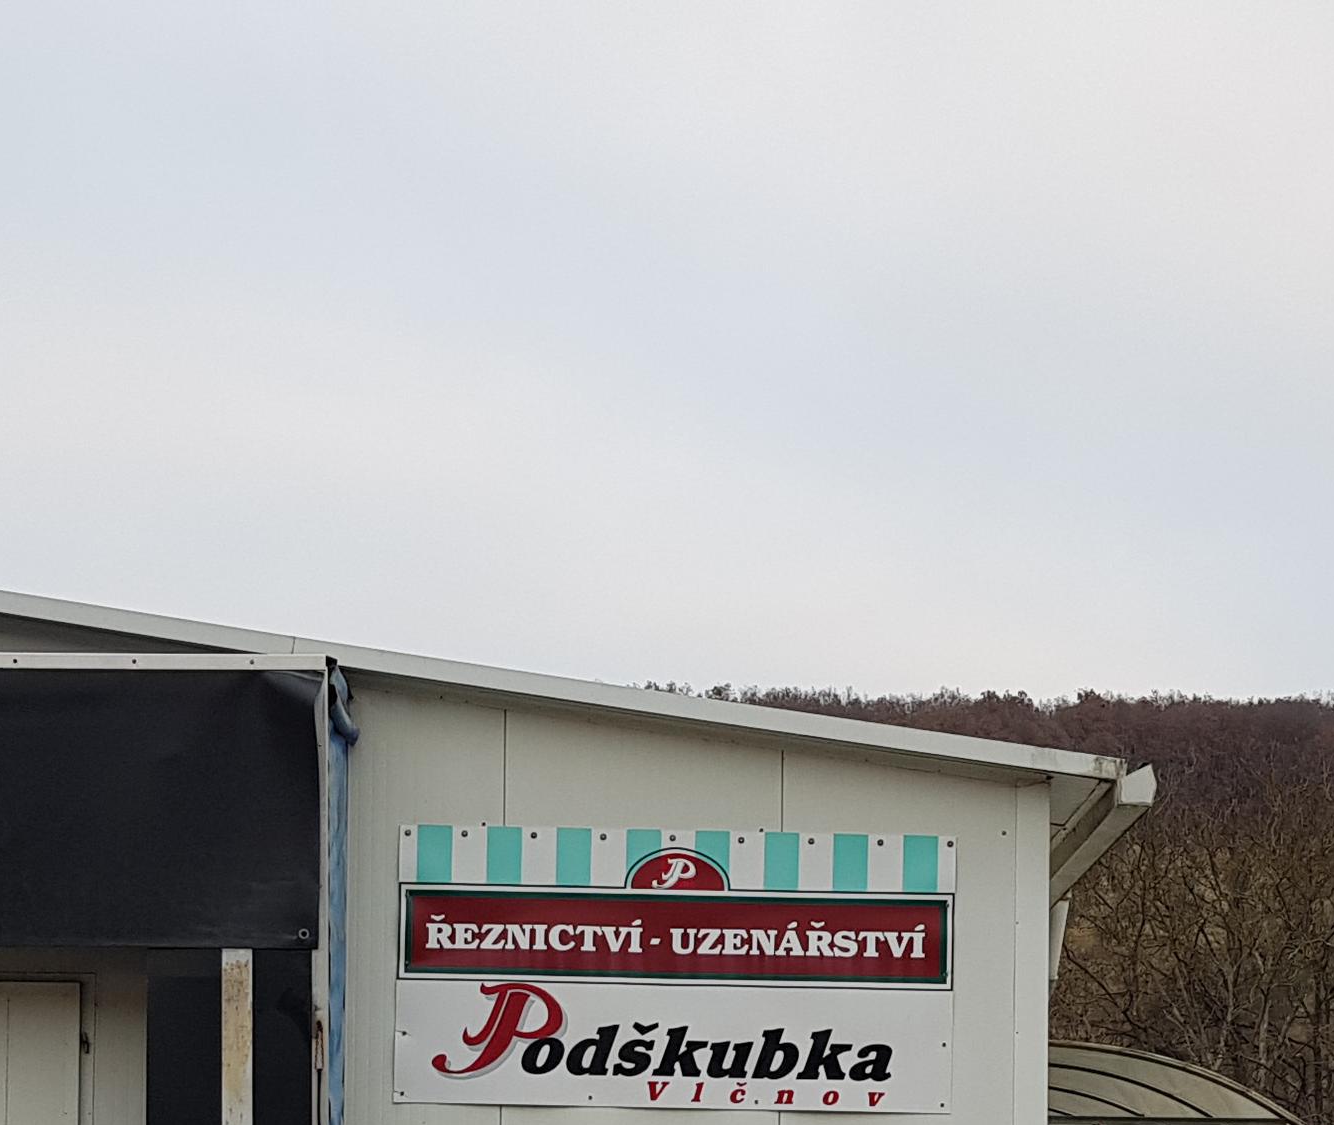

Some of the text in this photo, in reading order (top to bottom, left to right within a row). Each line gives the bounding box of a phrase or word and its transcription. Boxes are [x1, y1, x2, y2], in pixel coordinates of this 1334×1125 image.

[425, 914, 643, 953] ŘEZNICTVÍ
[670, 921, 925, 959] UZENÁŘSTVÍ
[432, 982, 893, 1082] Podškubka
